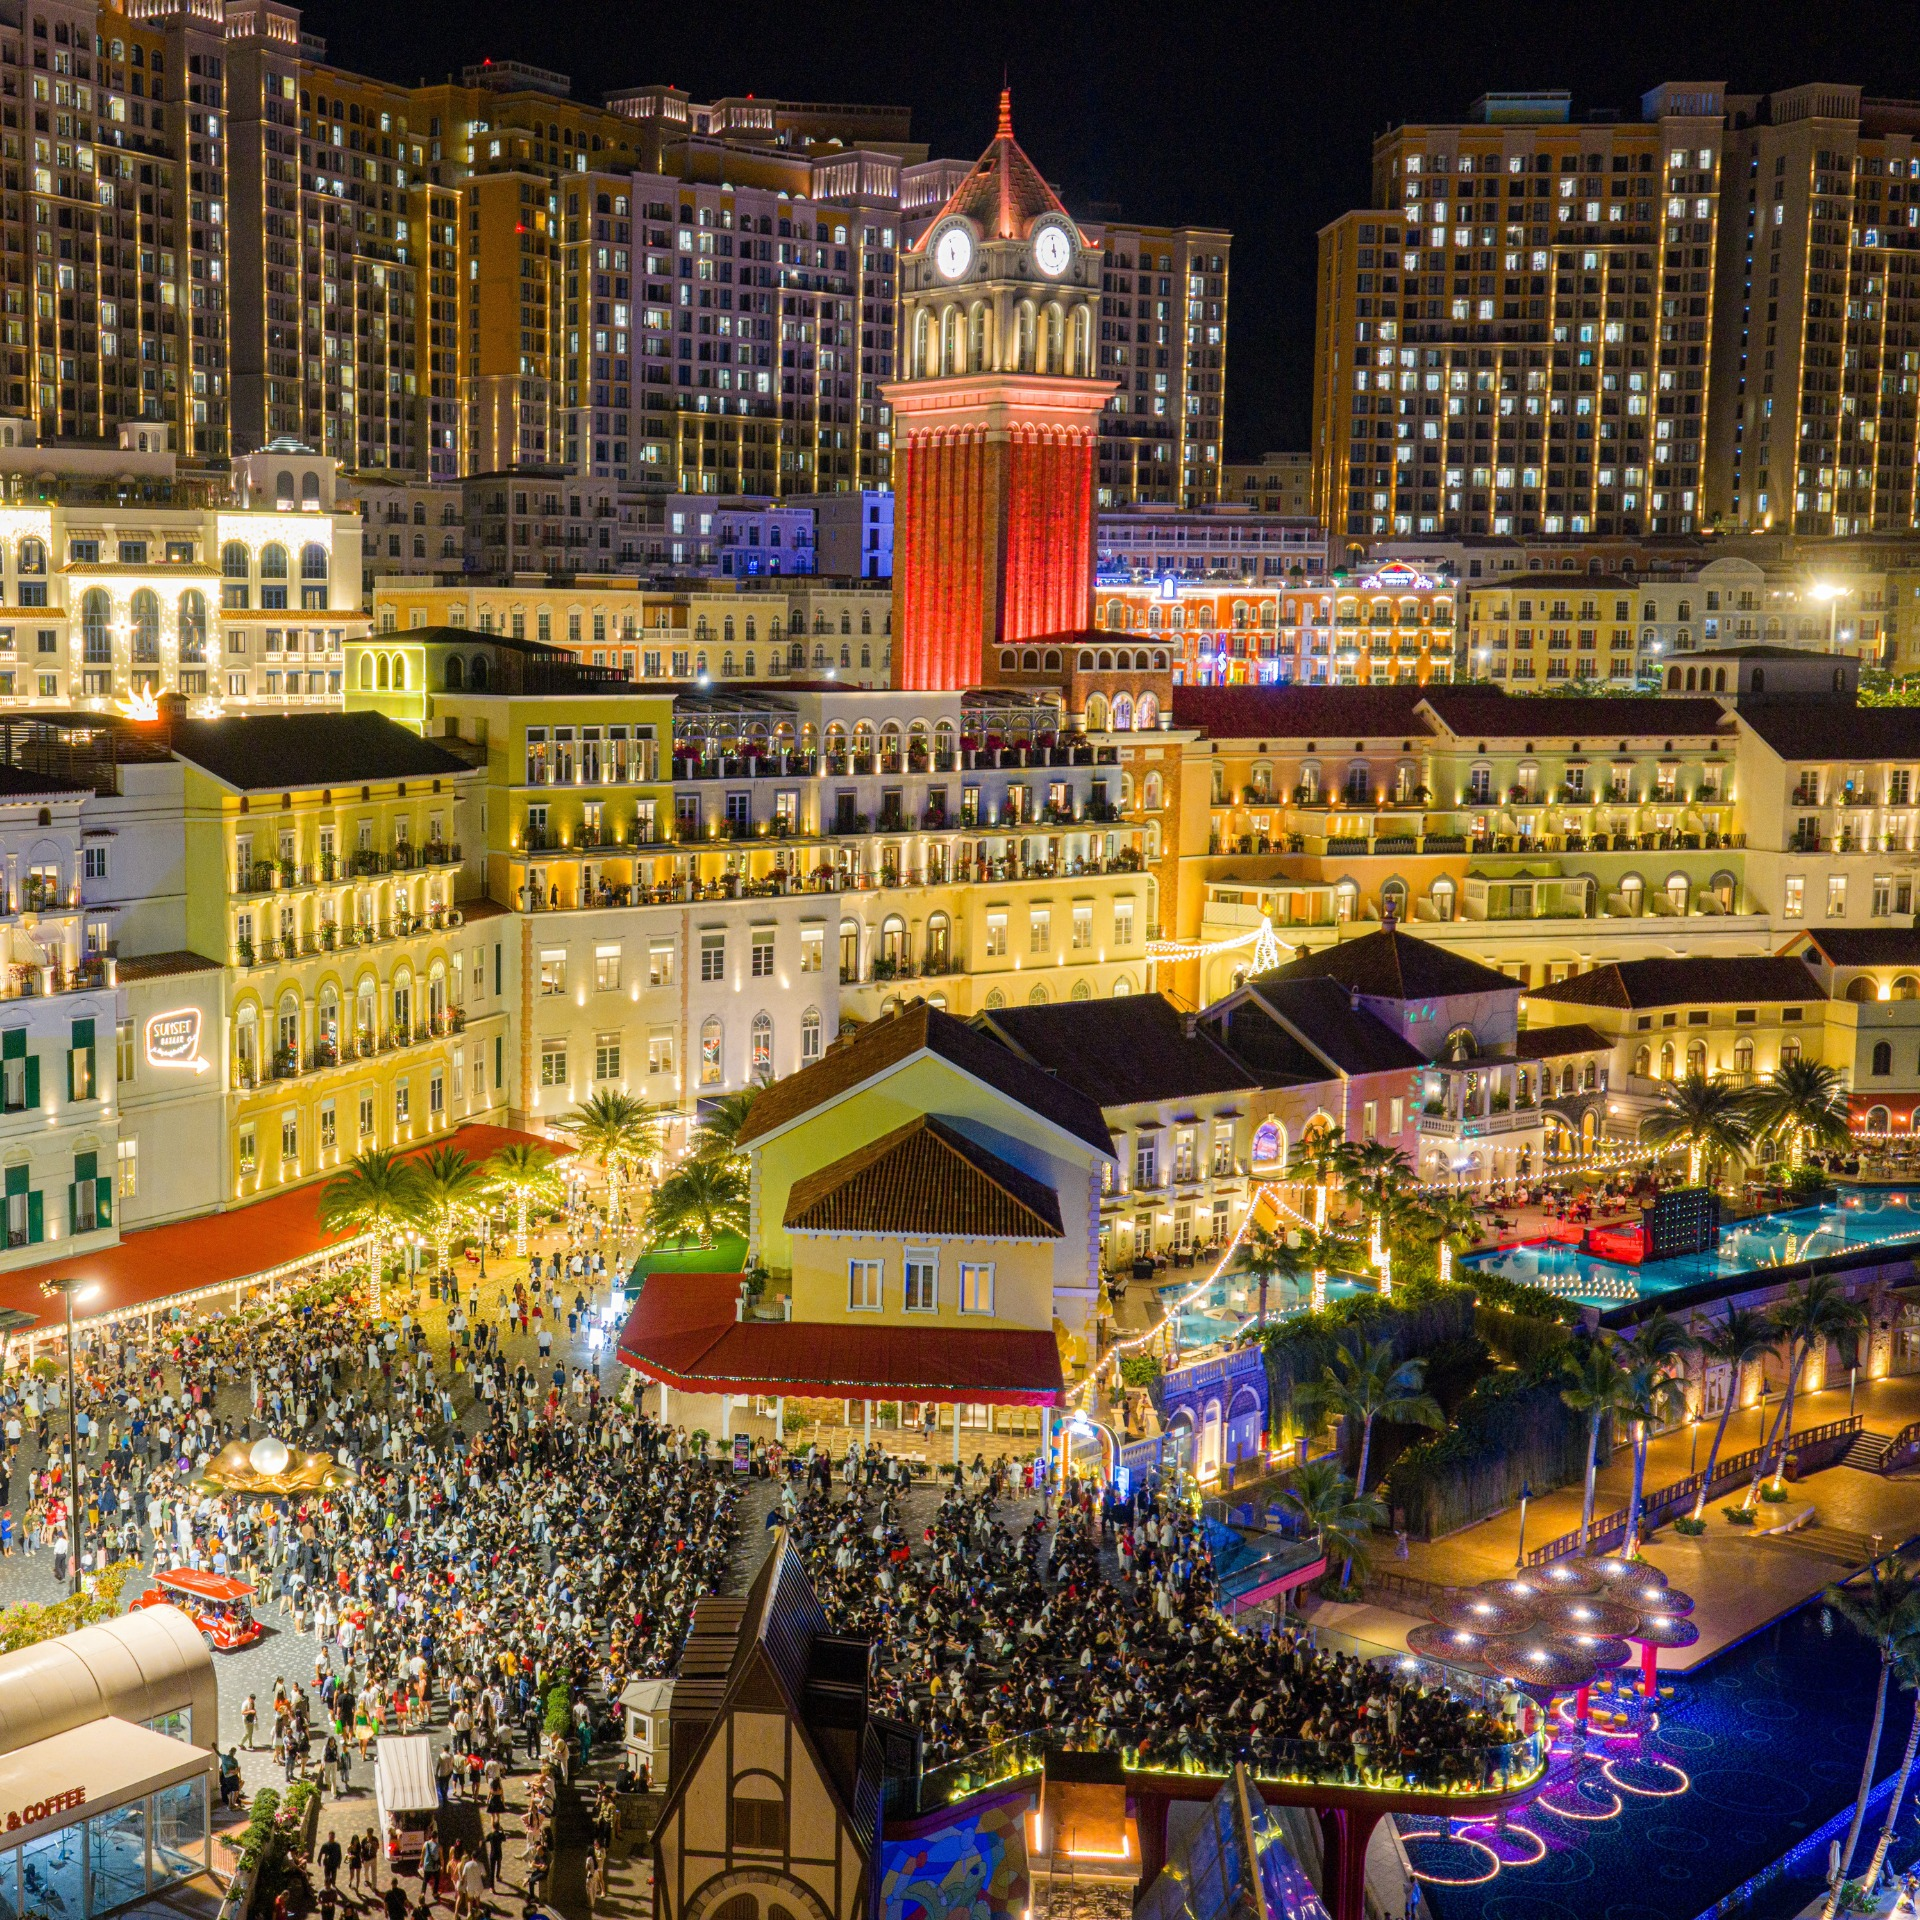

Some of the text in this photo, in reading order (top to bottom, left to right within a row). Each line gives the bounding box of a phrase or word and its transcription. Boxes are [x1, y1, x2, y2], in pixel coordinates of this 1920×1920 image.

[153, 1020, 191, 1037] SUNSET
[6, 1811, 22, 1831] &
[23, 1785, 86, 1825] COFFEE
